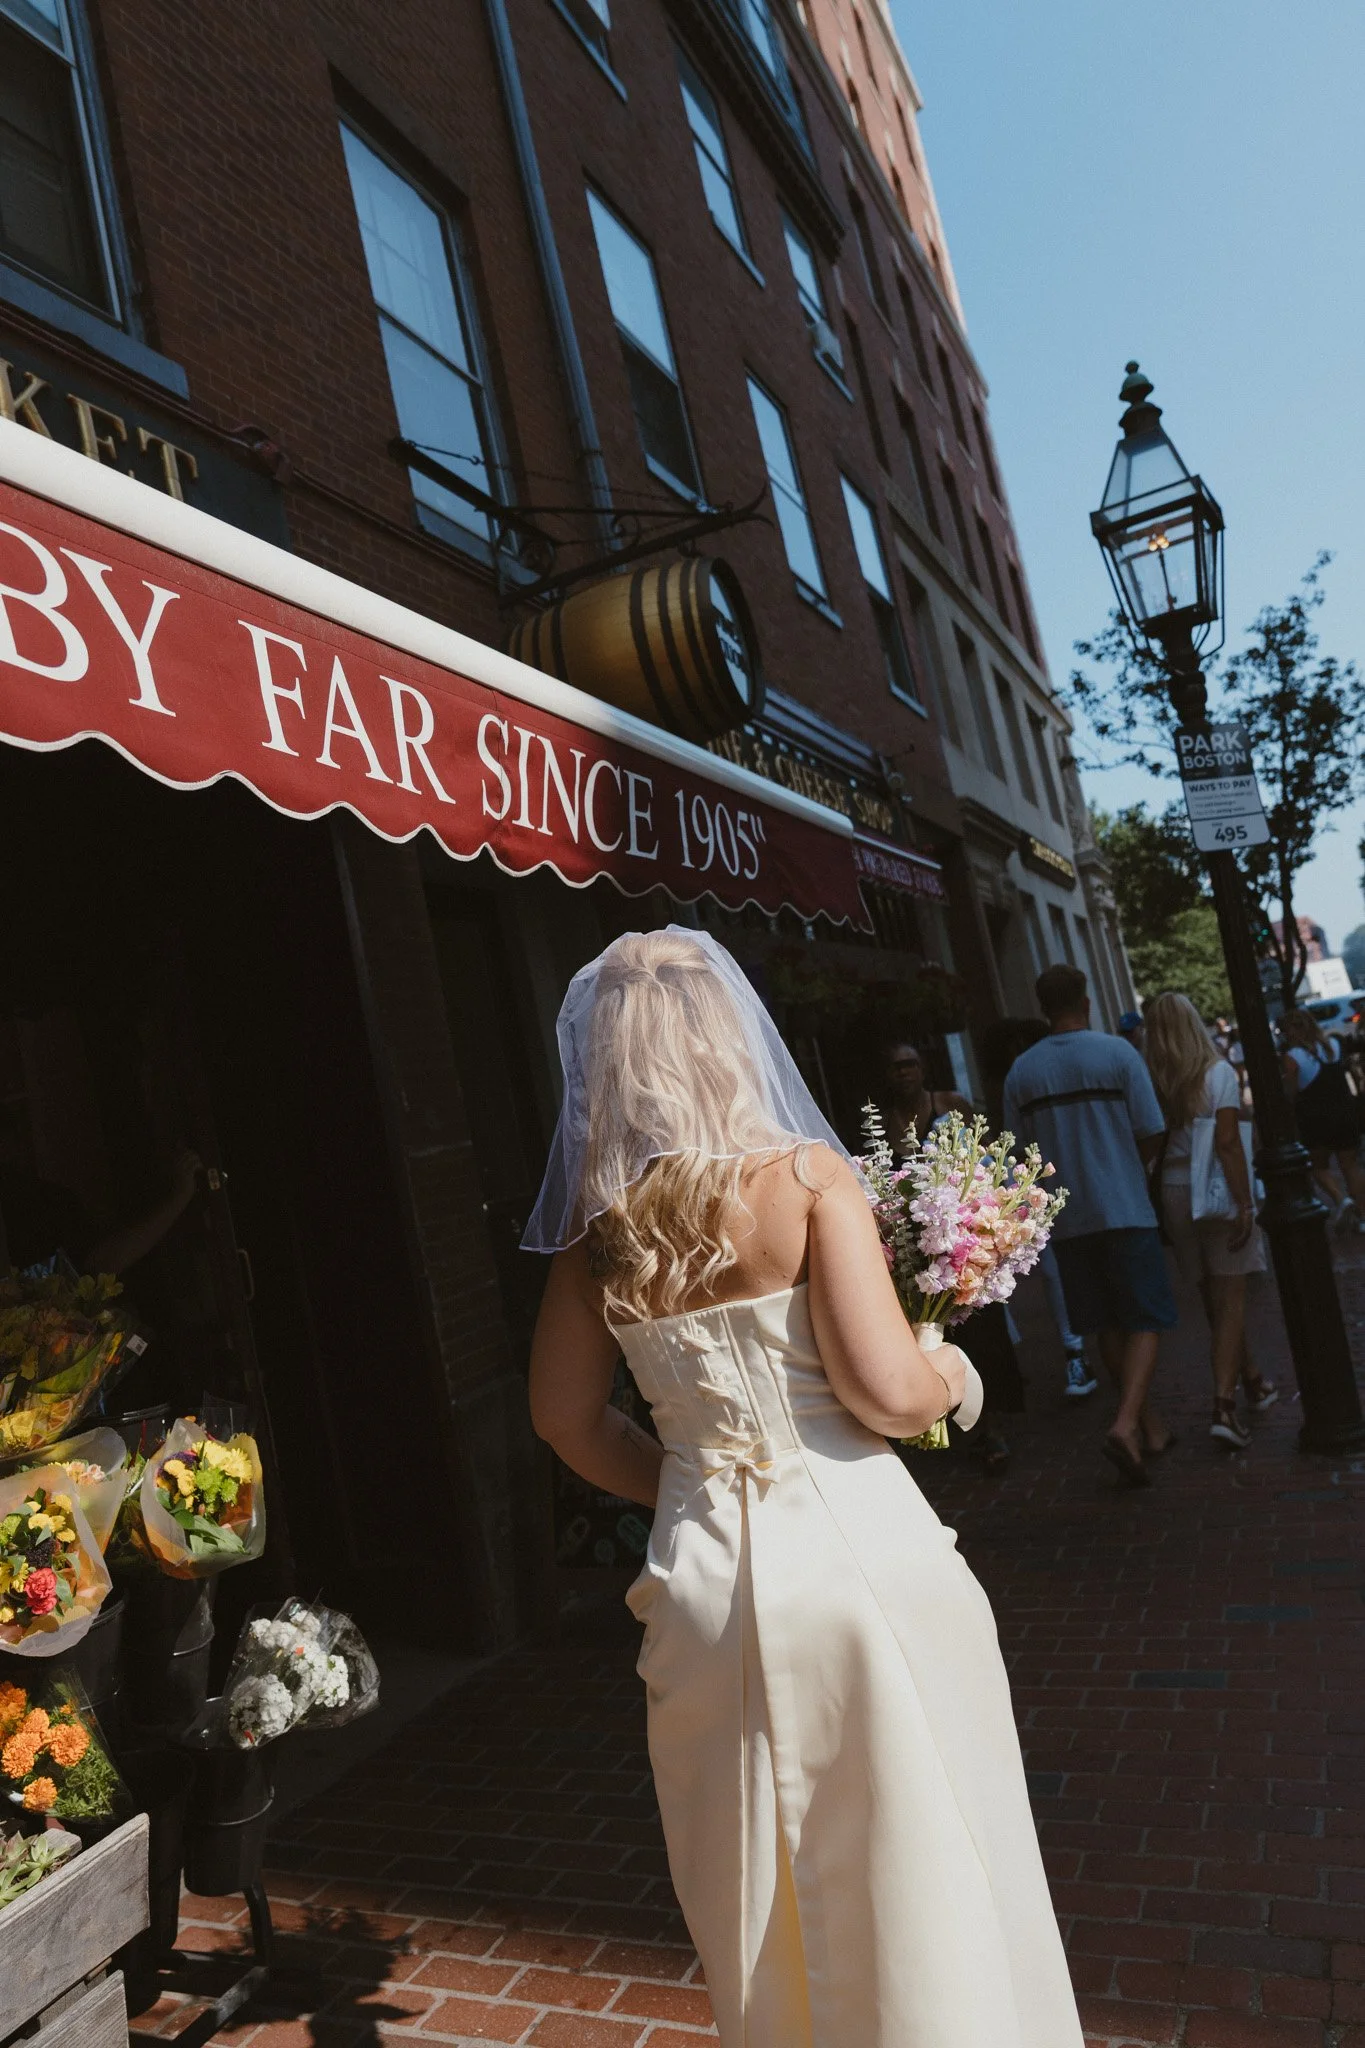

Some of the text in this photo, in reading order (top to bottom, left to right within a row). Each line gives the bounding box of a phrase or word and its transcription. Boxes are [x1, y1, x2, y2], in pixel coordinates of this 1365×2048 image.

[0, 520, 767, 880] BY FAR SINCE 1905"
[1180, 730, 1244, 754] PARK
[1183, 751, 1248, 769] BOSTON
[1188, 779, 1252, 793] WAYS TO PAY
[1214, 825, 1248, 842] 495
